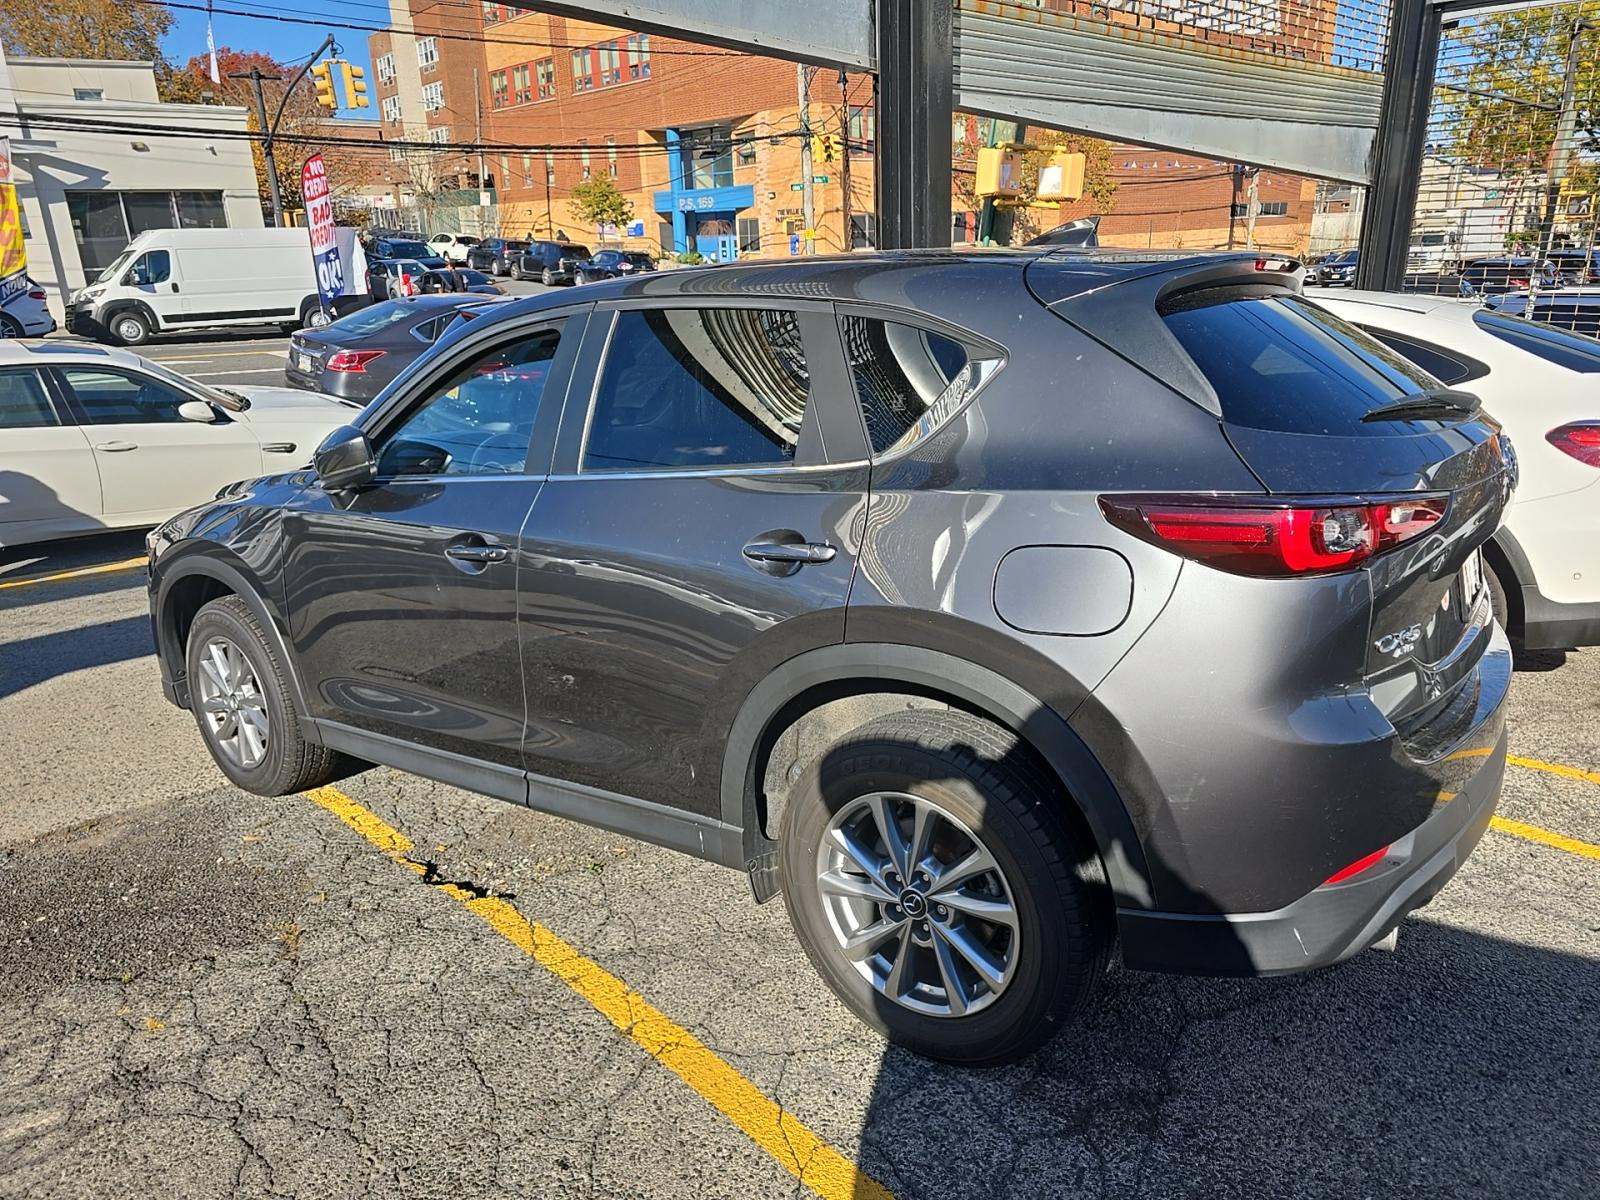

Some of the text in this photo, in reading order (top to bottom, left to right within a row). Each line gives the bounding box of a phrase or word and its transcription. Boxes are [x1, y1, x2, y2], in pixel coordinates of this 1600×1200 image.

[309, 160, 325, 175] NO
[304, 175, 329, 198] CREDIT
[312, 202, 331, 225] BAD
[311, 222, 337, 248] CREDIT
[318, 259, 344, 291] OK!
